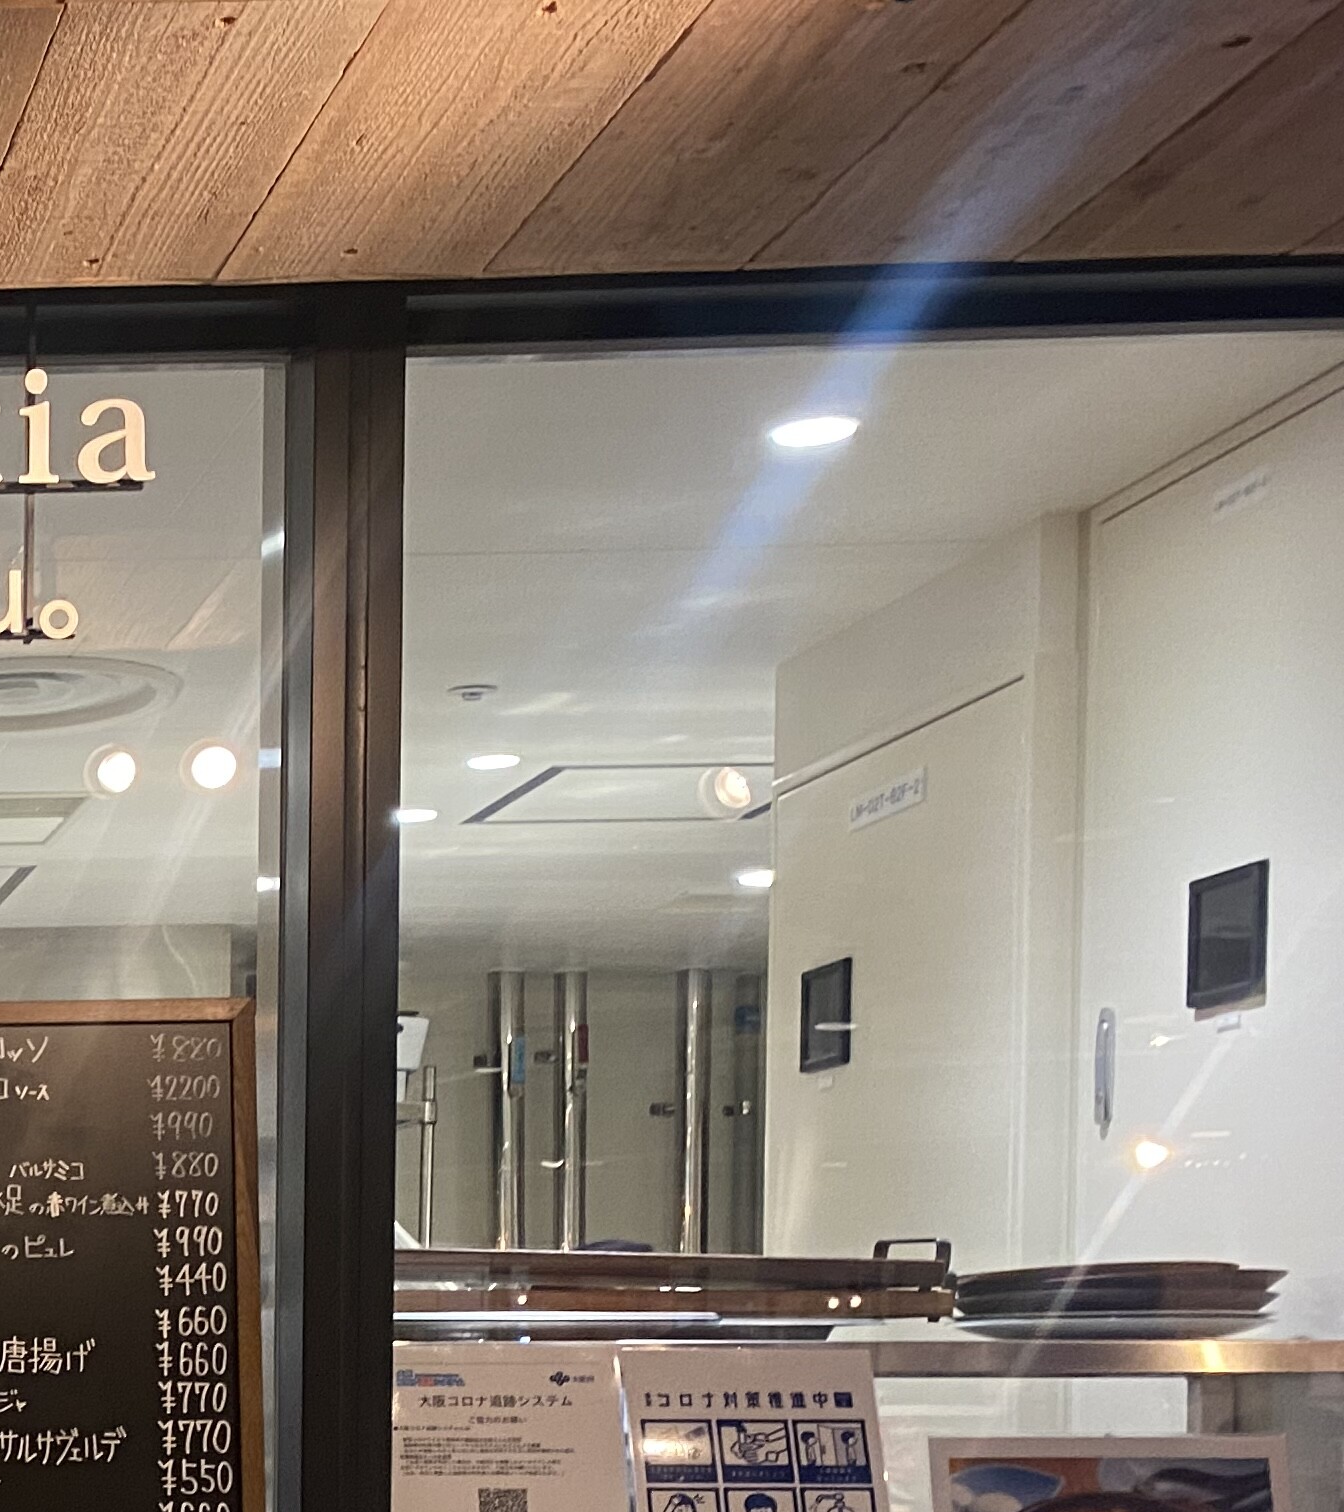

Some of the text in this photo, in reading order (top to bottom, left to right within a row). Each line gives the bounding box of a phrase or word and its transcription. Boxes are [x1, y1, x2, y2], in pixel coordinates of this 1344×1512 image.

[150, 1033, 222, 1063] ¥880
[146, 1074, 221, 1101] ¥2200
[149, 1111, 214, 1141] ¥990
[151, 1151, 219, 1180] ¥880
[157, 1189, 219, 1219] ¥770
[153, 1225, 223, 1259] ¥990
[155, 1261, 227, 1297] ¥440
[155, 1304, 228, 1339] ¥660
[155, 1341, 228, 1376] ¥660
[158, 1380, 228, 1414] ¥770
[157, 1419, 232, 1456] ¥770
[157, 1458, 234, 1496] ¥550
